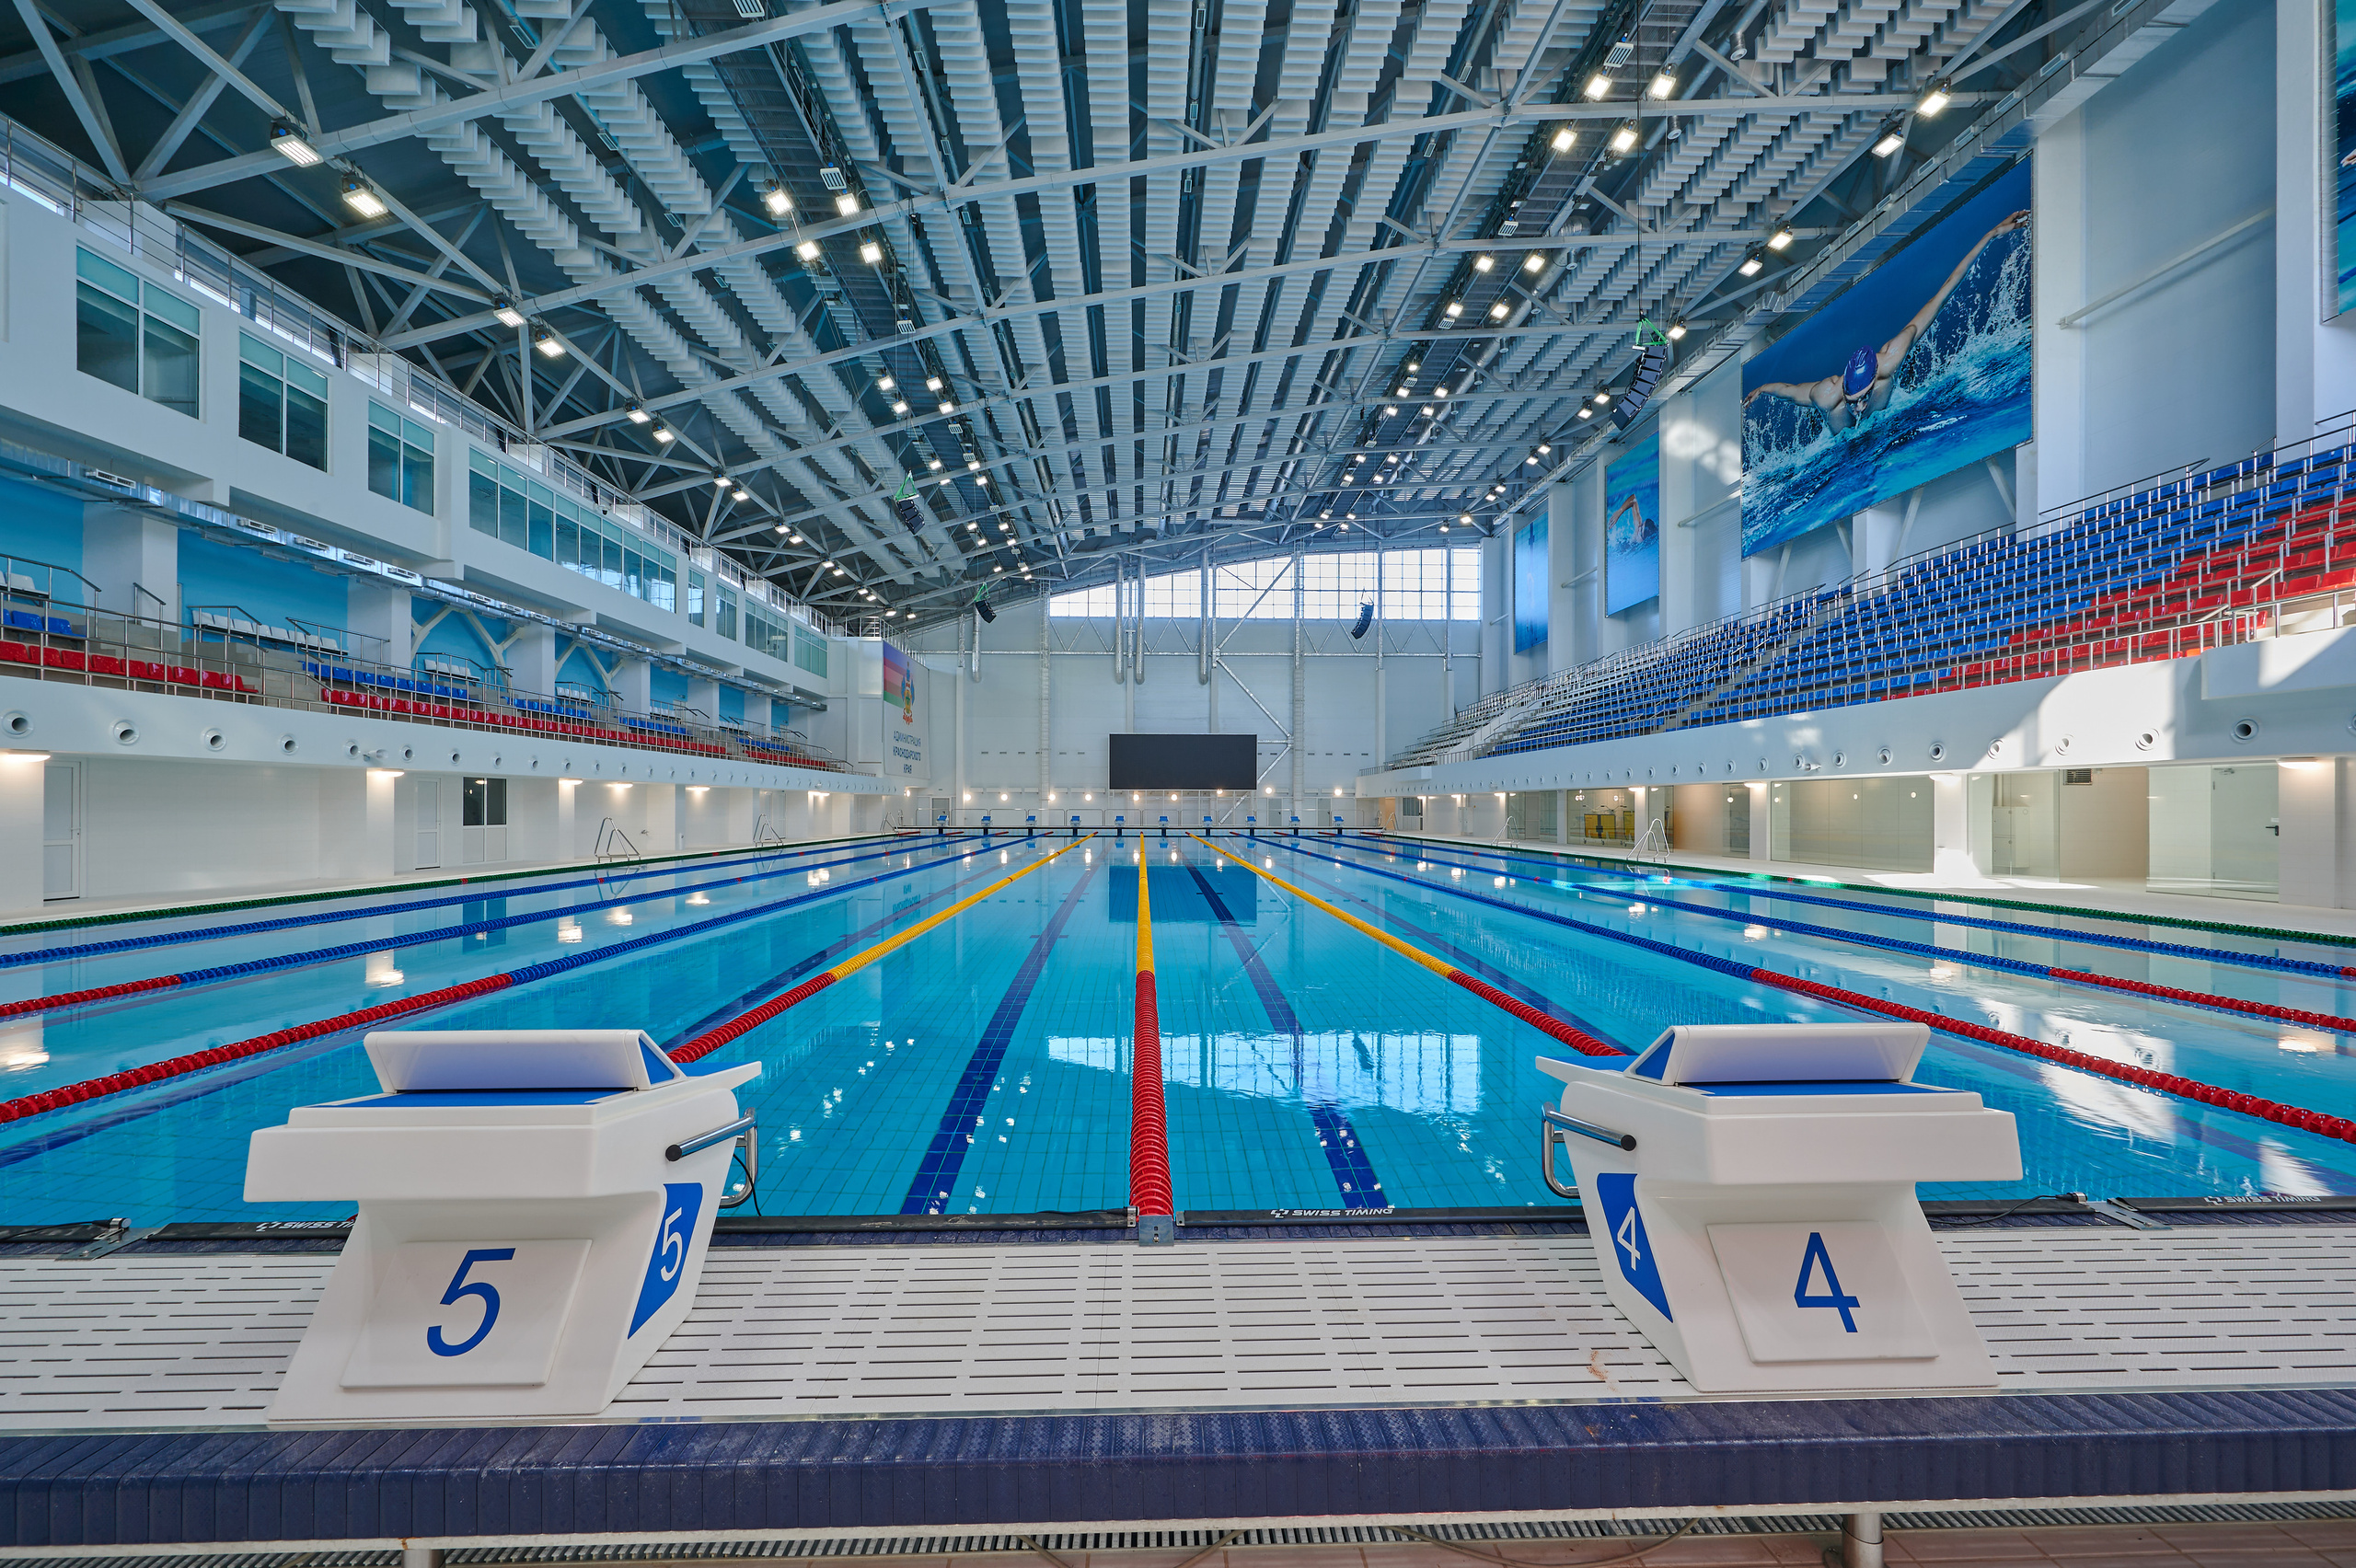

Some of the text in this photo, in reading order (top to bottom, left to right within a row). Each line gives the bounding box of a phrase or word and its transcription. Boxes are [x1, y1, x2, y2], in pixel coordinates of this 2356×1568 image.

[893, 730, 921, 747] АДМИНИСТРАЦИЯ
[903, 763, 912, 774] КРАЯ
[279, 1221, 338, 1229] SWISS
[660, 1207, 682, 1282] 5
[1617, 1206, 1641, 1271] 4
[427, 1248, 516, 1356] 5
[1794, 1232, 1861, 1332] 4
